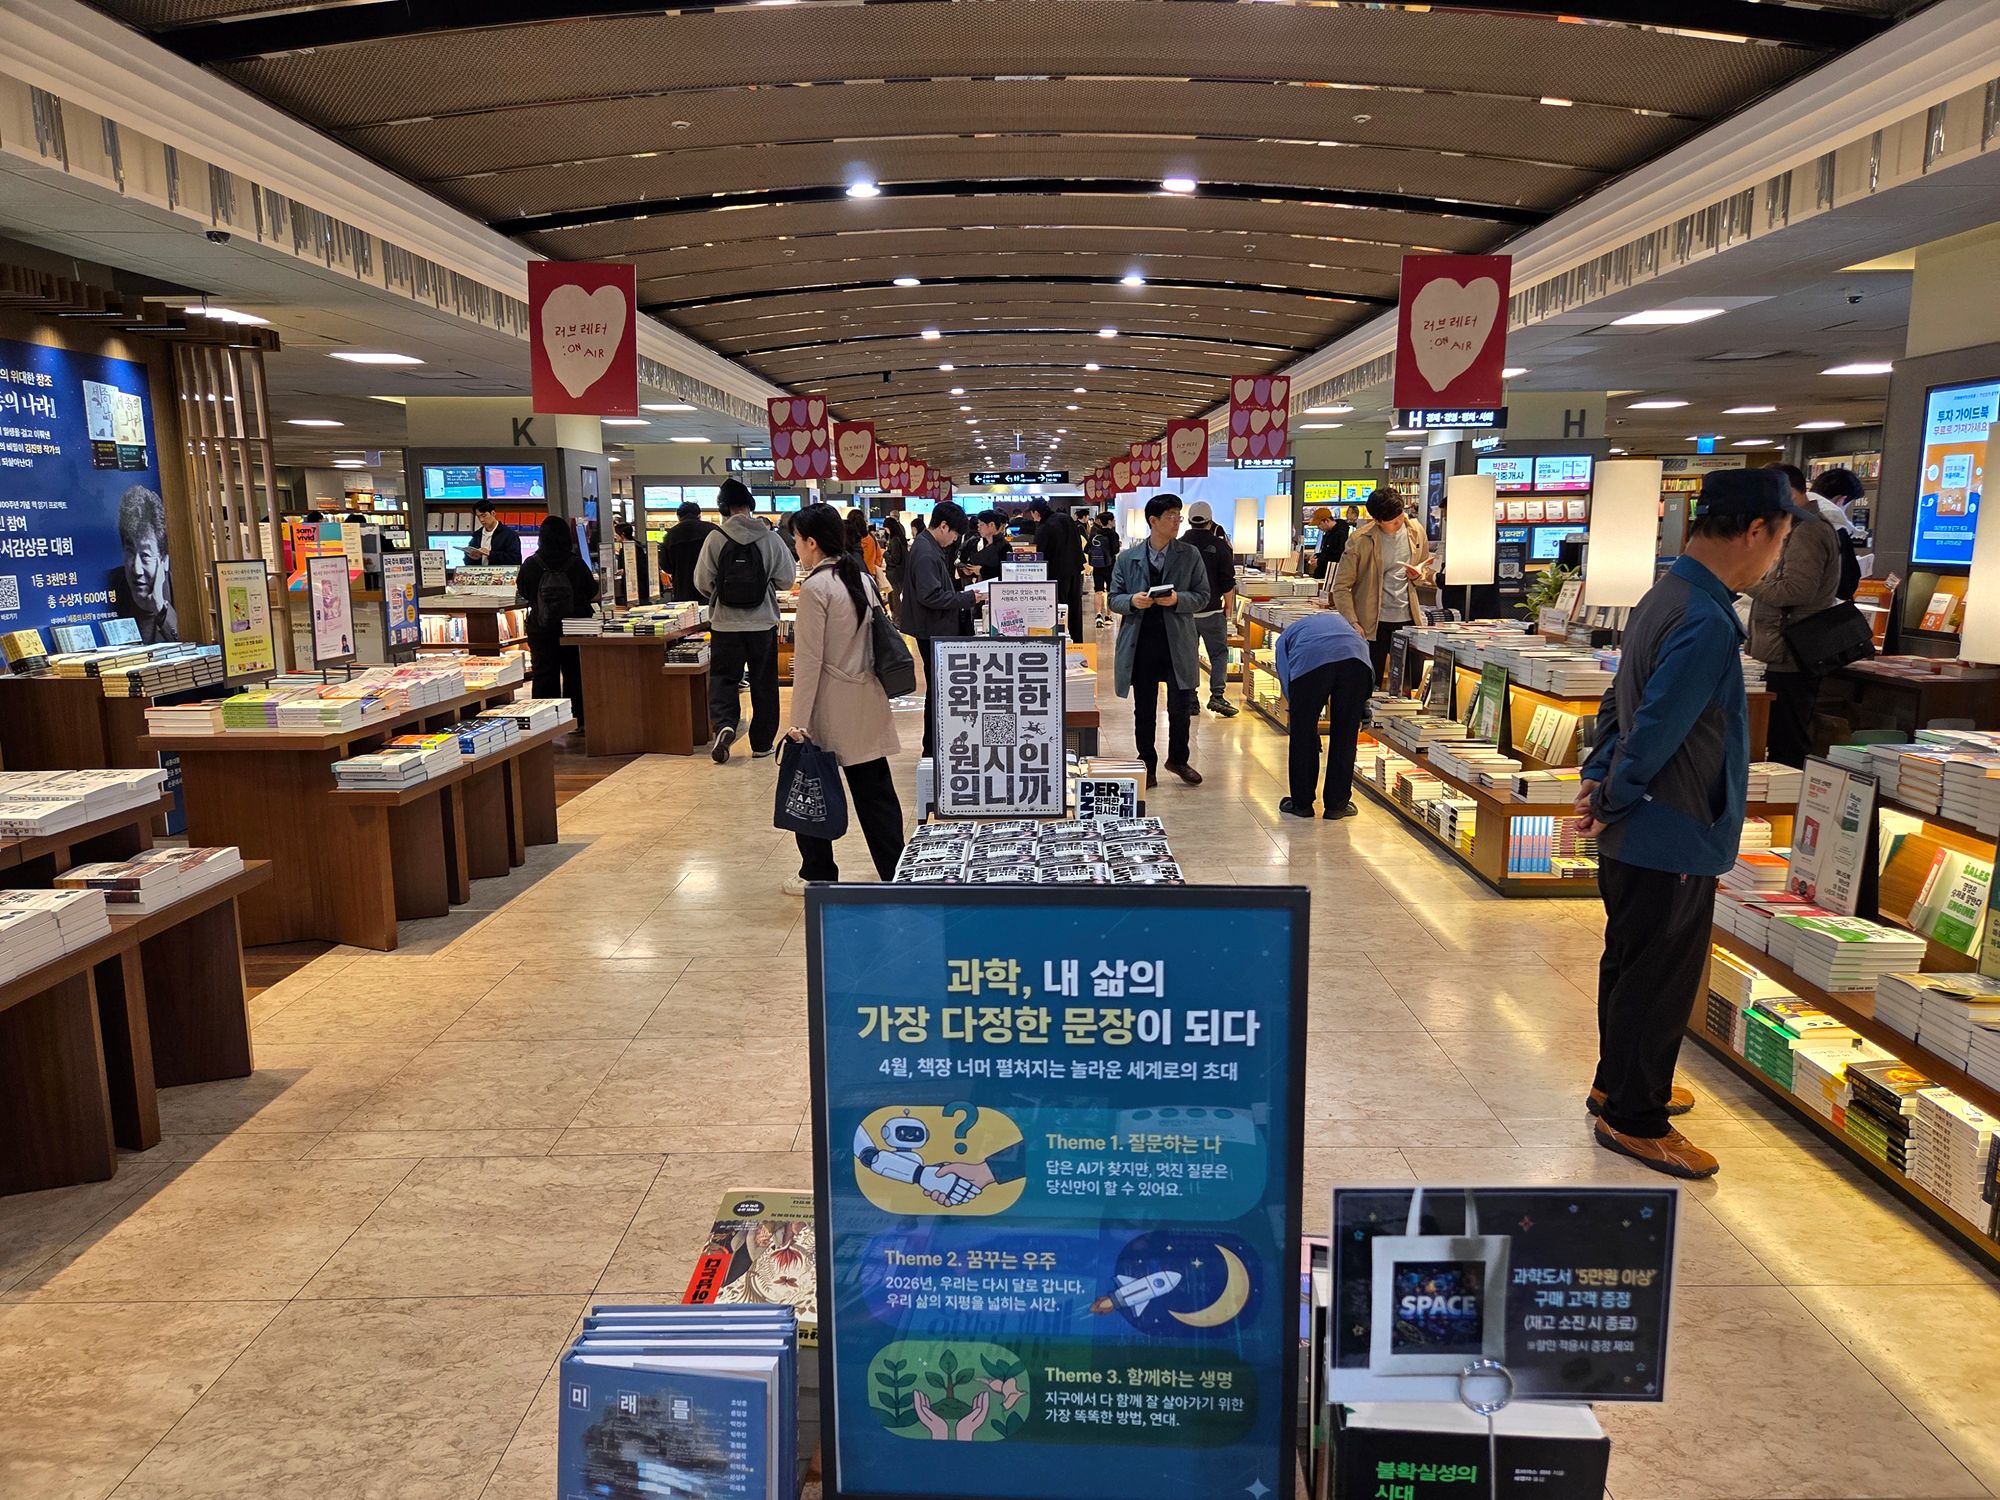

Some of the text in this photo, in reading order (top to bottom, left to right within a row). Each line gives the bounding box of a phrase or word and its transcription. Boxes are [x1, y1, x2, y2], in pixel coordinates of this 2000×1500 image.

[584, 349, 604, 358] AIR
[1451, 341, 1472, 350] AIR
[10, 371, 35, 386] 위대한
[36, 373, 53, 387] 창조
[1409, 411, 1422, 428] H
[1564, 409, 1585, 438] H
[1937, 406, 1989, 423] 투자 가이드북
[512, 417, 536, 446] K
[701, 456, 714, 474] K
[731, 459, 742, 471] K
[1493, 462, 1517, 471] 박문각
[7, 516, 27, 532] 참여
[297, 533, 315, 541] vivid
[0, 537, 73, 558] 서감상문 대회
[31, 572, 78, 588] 1등 3천만 원
[59, 594, 83, 608] 수상자
[84, 592, 107, 604] 600여
[108, 590, 117, 603] 명
[948, 652, 1049, 684] 당신은
[948, 684, 1051, 716] 완벽한
[949, 743, 1050, 774] 원시인
[950, 774, 1051, 806] 입니까
[1095, 797, 1120, 805] 완벽한
[1095, 806, 1119, 815] 원시인
[1963, 864, 1990, 883] SALES
[1947, 900, 1977, 920] ENGINE
[947, 958, 1165, 999] 과학, 내 삶의
[857, 1005, 1261, 1048] 가장 다정한 문장이 되다
[879, 1058, 1238, 1082] 4월, 책장 너머 펼쳐지는 놀라운 세계로의 초대
[1046, 1134, 1222, 1154] Theme 1. 질문하는 나
[1046, 1160, 1228, 1180] 답은 AI가 찾지만, 멋진 질문은
[1046, 1180, 1183, 1197] 당신만이 할 수 있어요.
[885, 1250, 1057, 1271] Theme 2. 꿈꾸는 우주
[886, 1276, 1085, 1295] 2026년, 우리는 다시 달로 갑니다.
[1513, 1268, 1572, 1286] 과학도서
[886, 1294, 1060, 1312] 우리 삶의 지평을 넓히는 시간.
[1400, 1295, 1477, 1319] SPACE
[1535, 1290, 1632, 1308] 구매 고객 증정
[1524, 1315, 1637, 1332] (재고 소진 시 종료)
[1045, 1367, 1232, 1389] Theme 3. 함께하는 생명
[1045, 1391, 1244, 1412] 지구에서 다 함께 잘 살아가기 위한
[1045, 1408, 1180, 1427] 가장 똑똑한 방법, 연대.
[1375, 1461, 1478, 1483] 불확실성의
[1375, 1484, 1415, 1500] 시대
